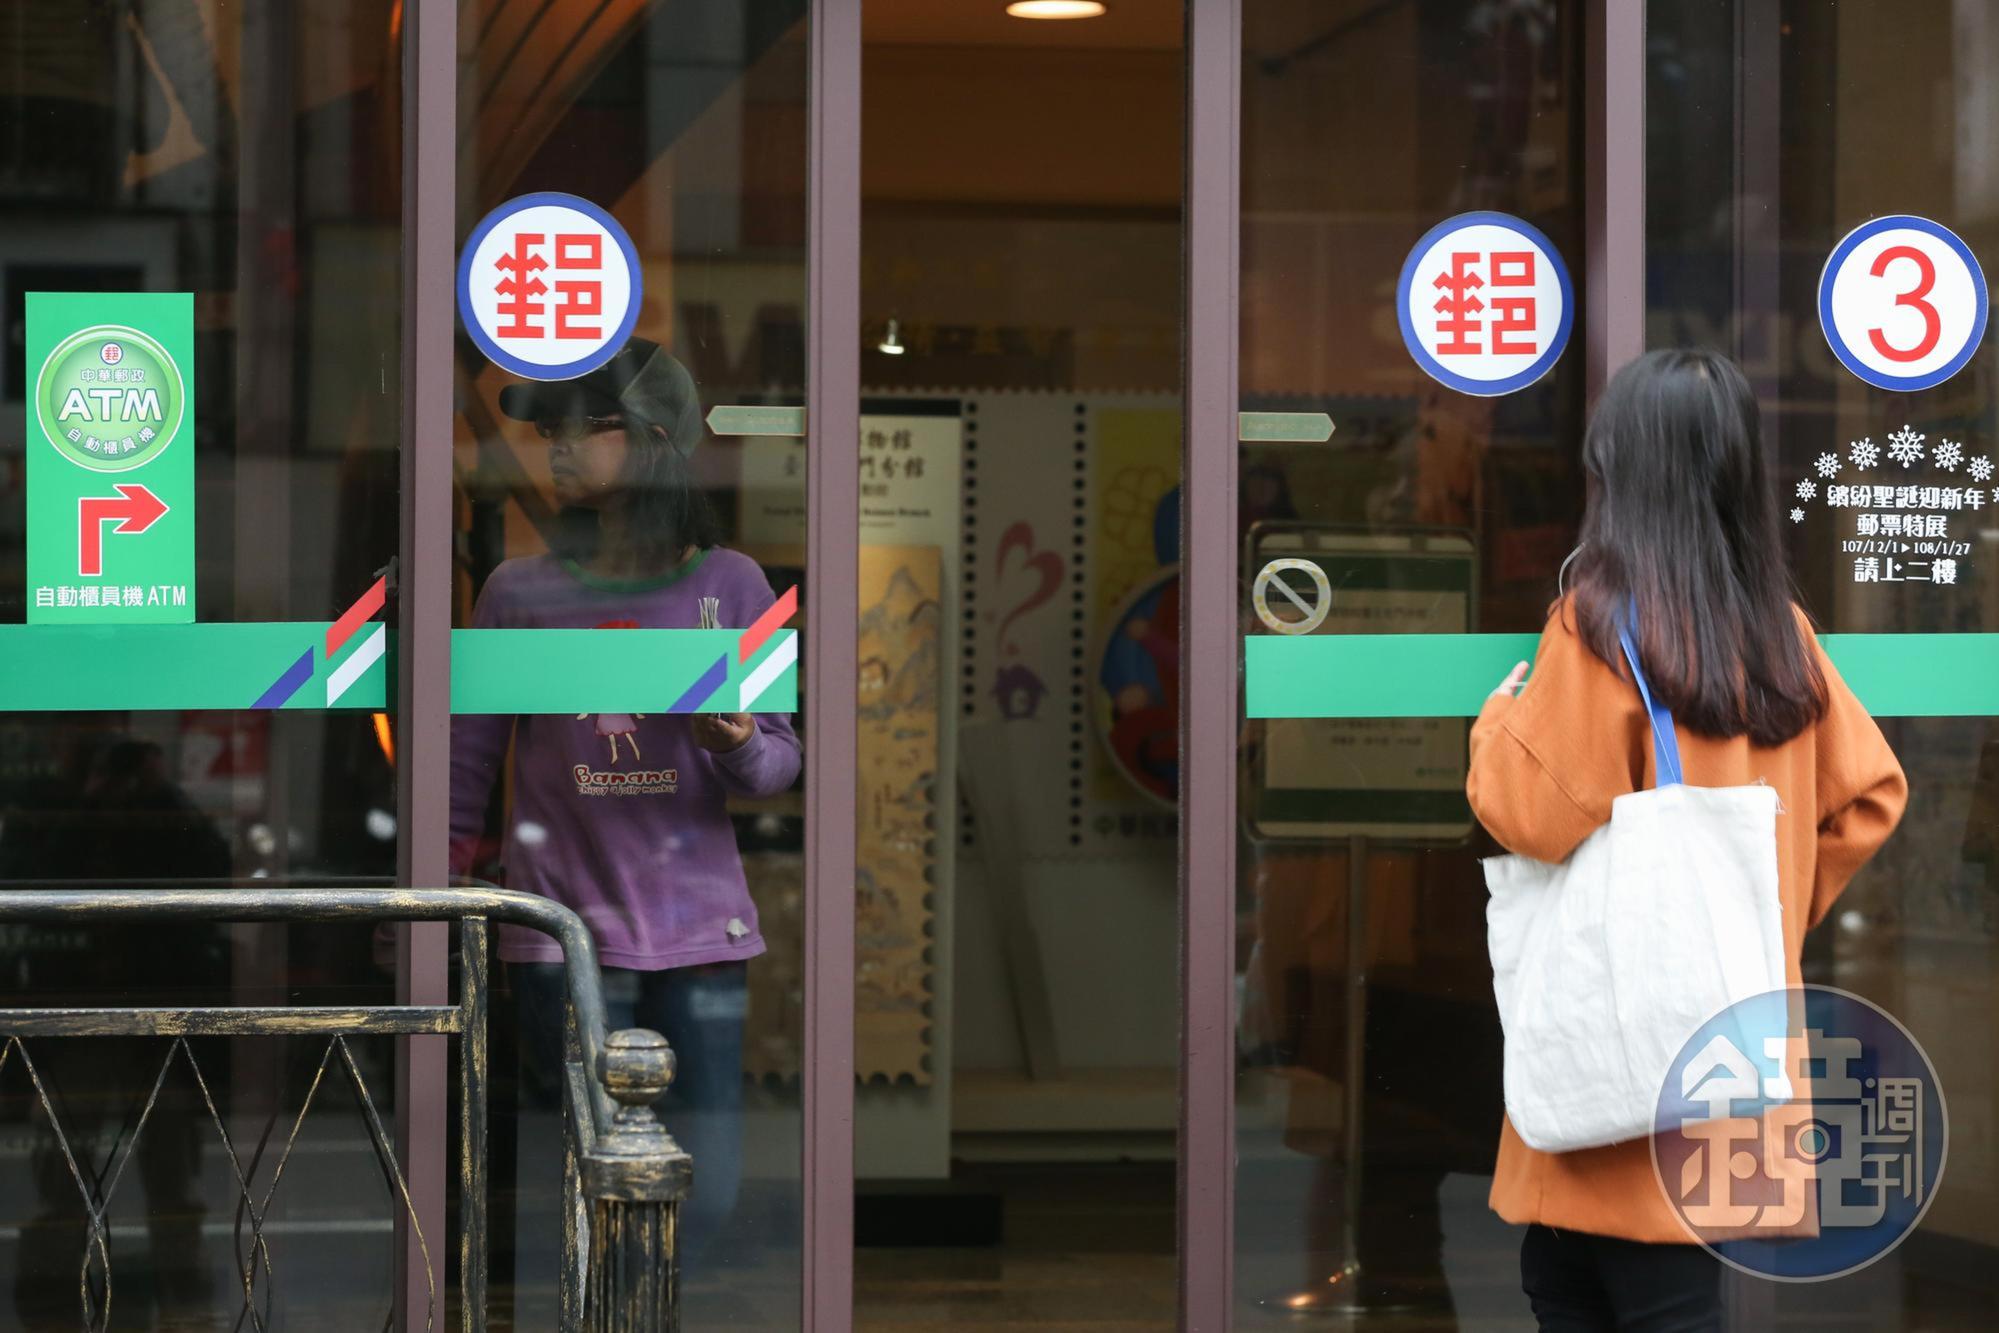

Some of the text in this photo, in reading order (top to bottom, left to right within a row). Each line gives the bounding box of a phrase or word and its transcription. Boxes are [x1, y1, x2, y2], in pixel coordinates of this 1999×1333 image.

[494, 233, 602, 340] 郵
[1432, 251, 1537, 355] 郵
[1867, 245, 1942, 363] 3
[81, 368, 145, 383] 中華郵政
[57, 388, 163, 422] ATM
[67, 426, 156, 455] 自動櫃員機
[860, 429, 913, 451] 物館
[1827, 484, 1986, 511] 繽紛聖誕迎新年
[1856, 513, 1948, 538] 郵票特展
[1853, 557, 1958, 585] 請上二樓
[35, 585, 186, 608] 自動櫃員機 ATM
[573, 764, 678, 785] Banana
